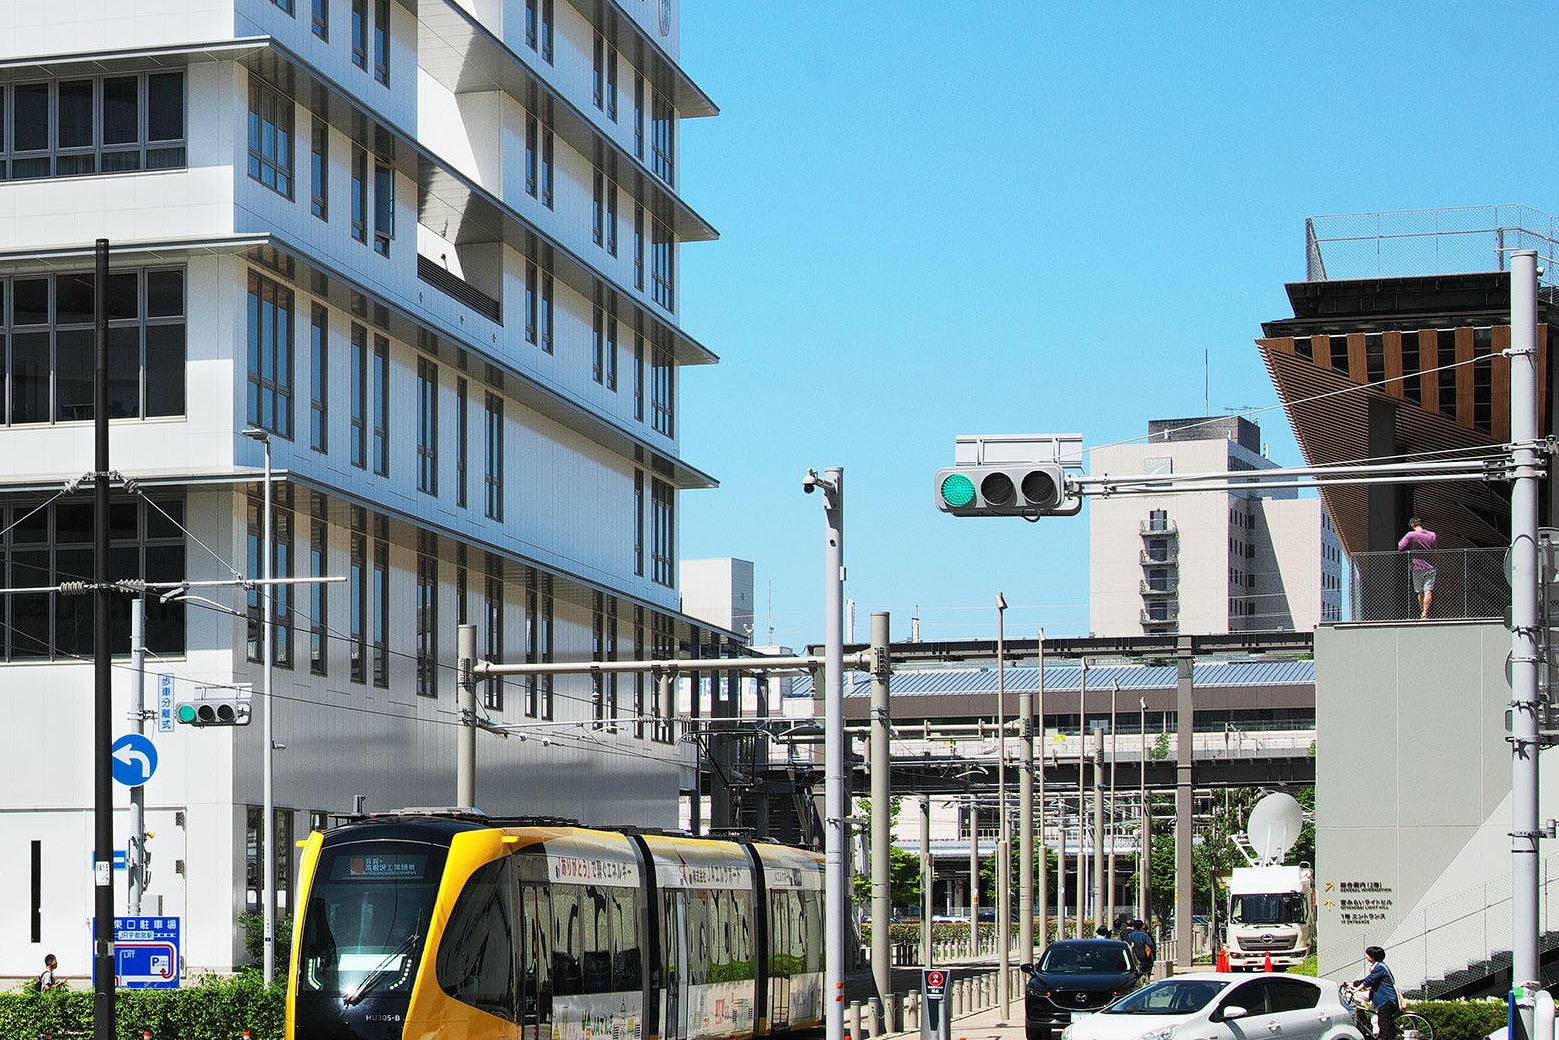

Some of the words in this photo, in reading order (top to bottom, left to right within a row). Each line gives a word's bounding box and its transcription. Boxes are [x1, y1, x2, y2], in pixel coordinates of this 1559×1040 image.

[161, 677, 172, 730] 歩車分離式
[114, 920, 176, 929] 東口駐車場
[152, 957, 159, 966] P
